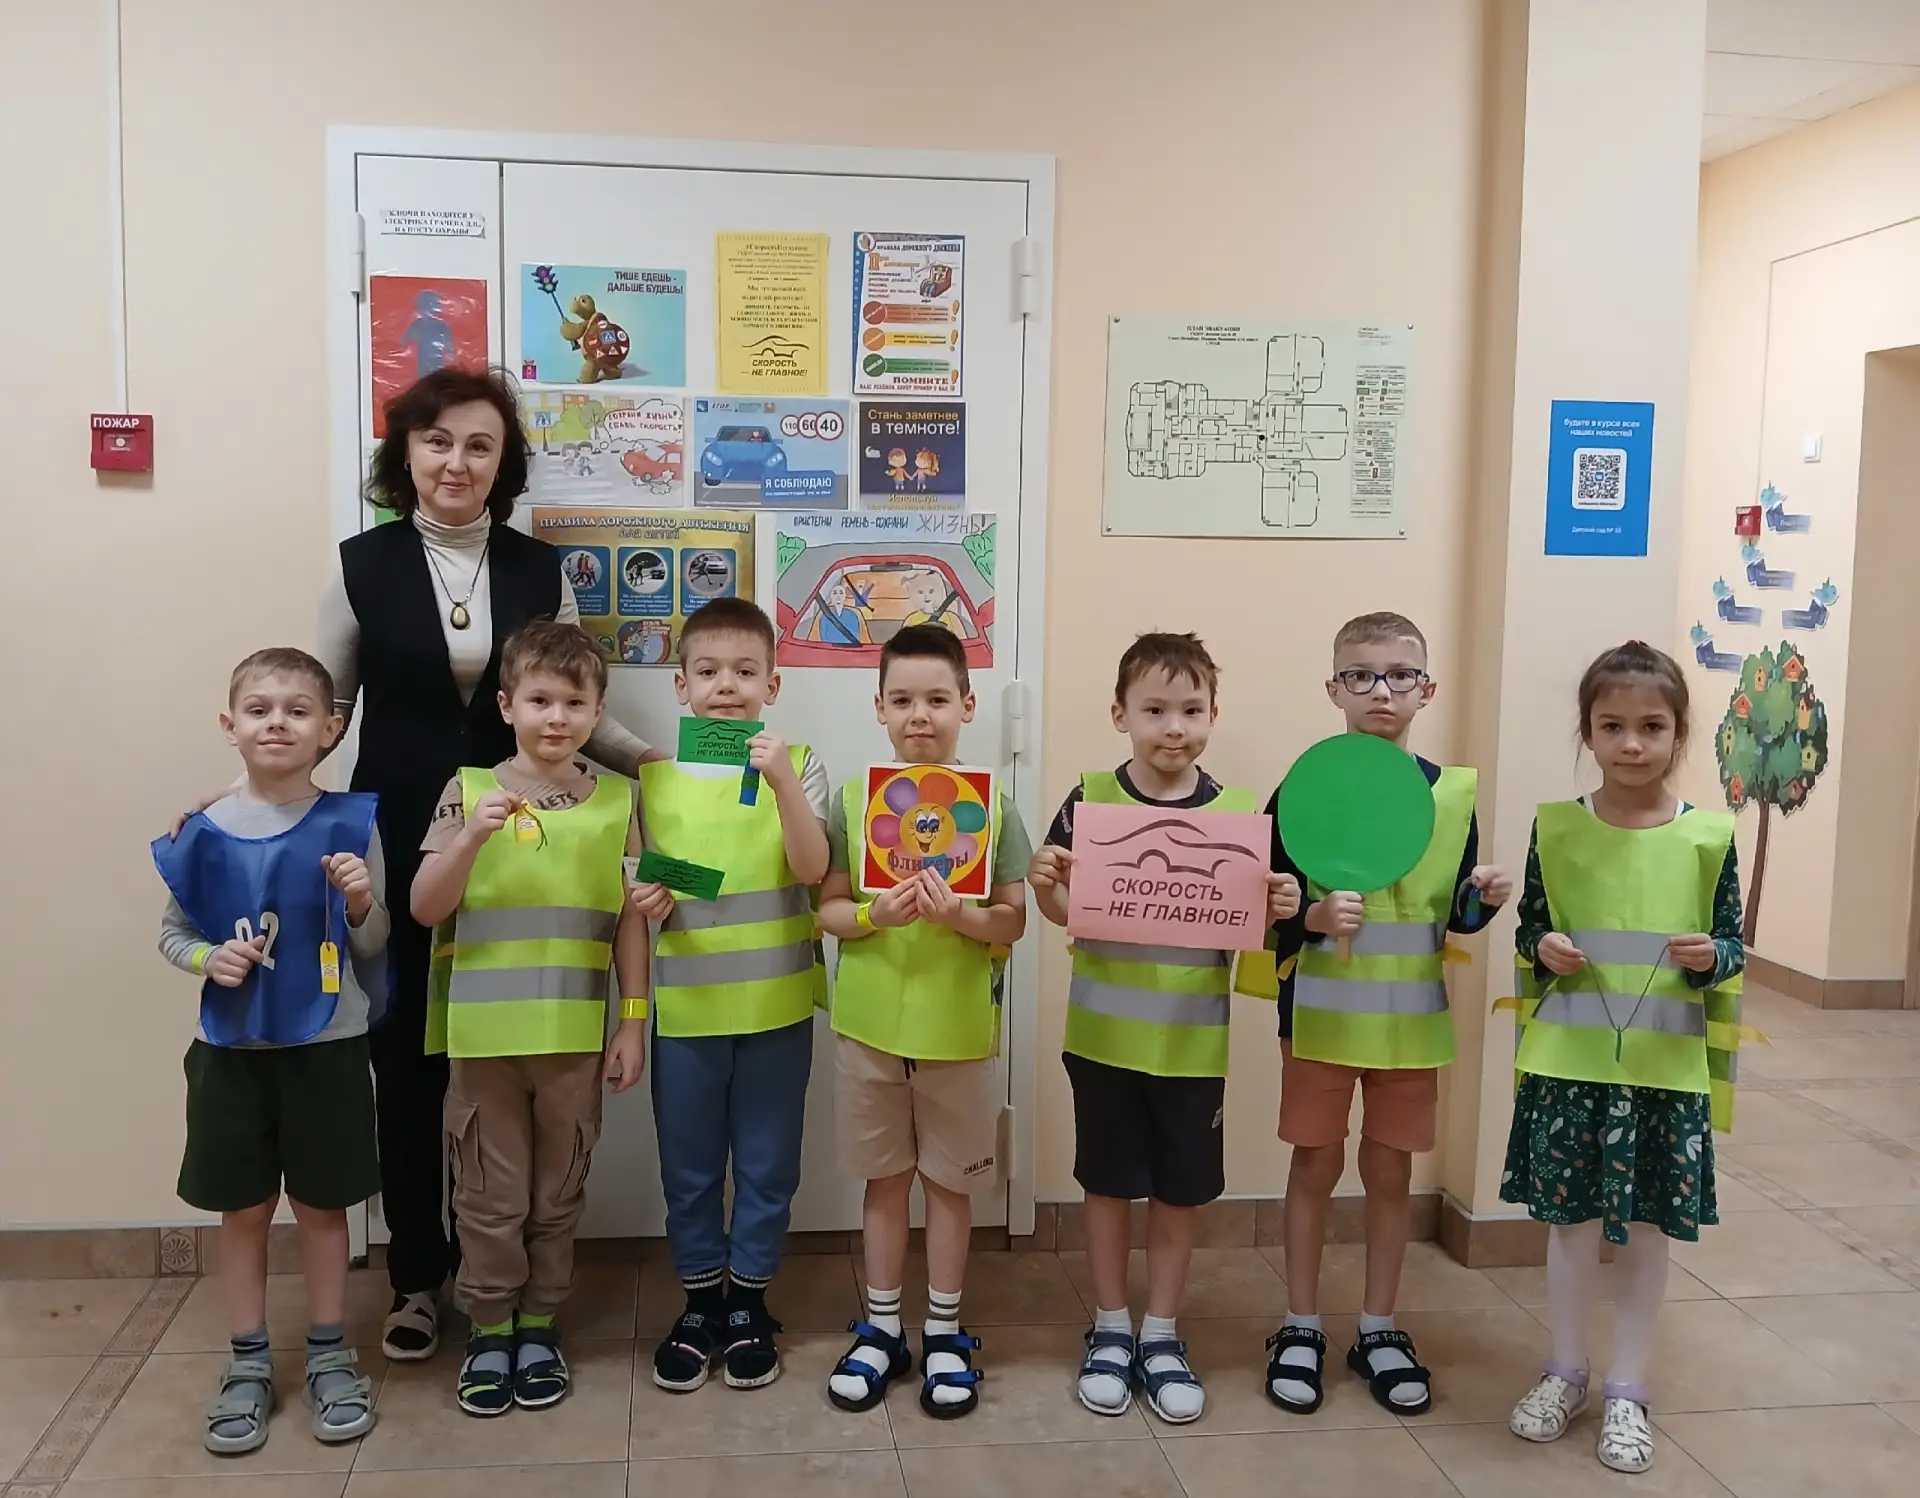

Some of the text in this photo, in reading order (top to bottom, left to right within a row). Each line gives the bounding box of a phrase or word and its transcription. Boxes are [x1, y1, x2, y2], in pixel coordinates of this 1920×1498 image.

[614, 270, 639, 281] ТИШЕ
[641, 272, 672, 282] ЕДЕШЬ
[607, 282, 684, 295] ДАЛЬШЕ БУДЕШЬ!
[751, 359, 798, 367] СКОРОСТЬ
[765, 369, 808, 377] ГЛАВНОЕ!
[893, 376, 949, 385] ПОМНИТЕ
[608, 410, 642, 420] СОХРАНИ
[868, 408, 959, 420] Стань заметнее
[93, 416, 140, 428] ПОЖАР
[608, 421, 683, 434] СБАВЬ СКОРОСТЬ!
[819, 419, 838, 432] 40
[885, 420, 960, 435] темноте!
[1595, 429, 1633, 437] новостей
[765, 477, 832, 489] Я СОБЛЮДАЮ
[540, 517, 750, 533] ПРАВИЛА ДОРОЖНОГО ДВИЖЕНИЯ
[697, 741, 739, 750] СКОРОСТЬ
[696, 749, 708, 757] НЕ
[536, 790, 579, 810] LETS
[1111, 877, 1224, 901] СКОРОСТЬ
[1108, 900, 1138, 918] НЕ
[1142, 903, 1249, 927] ГЛАВНОЕ!
